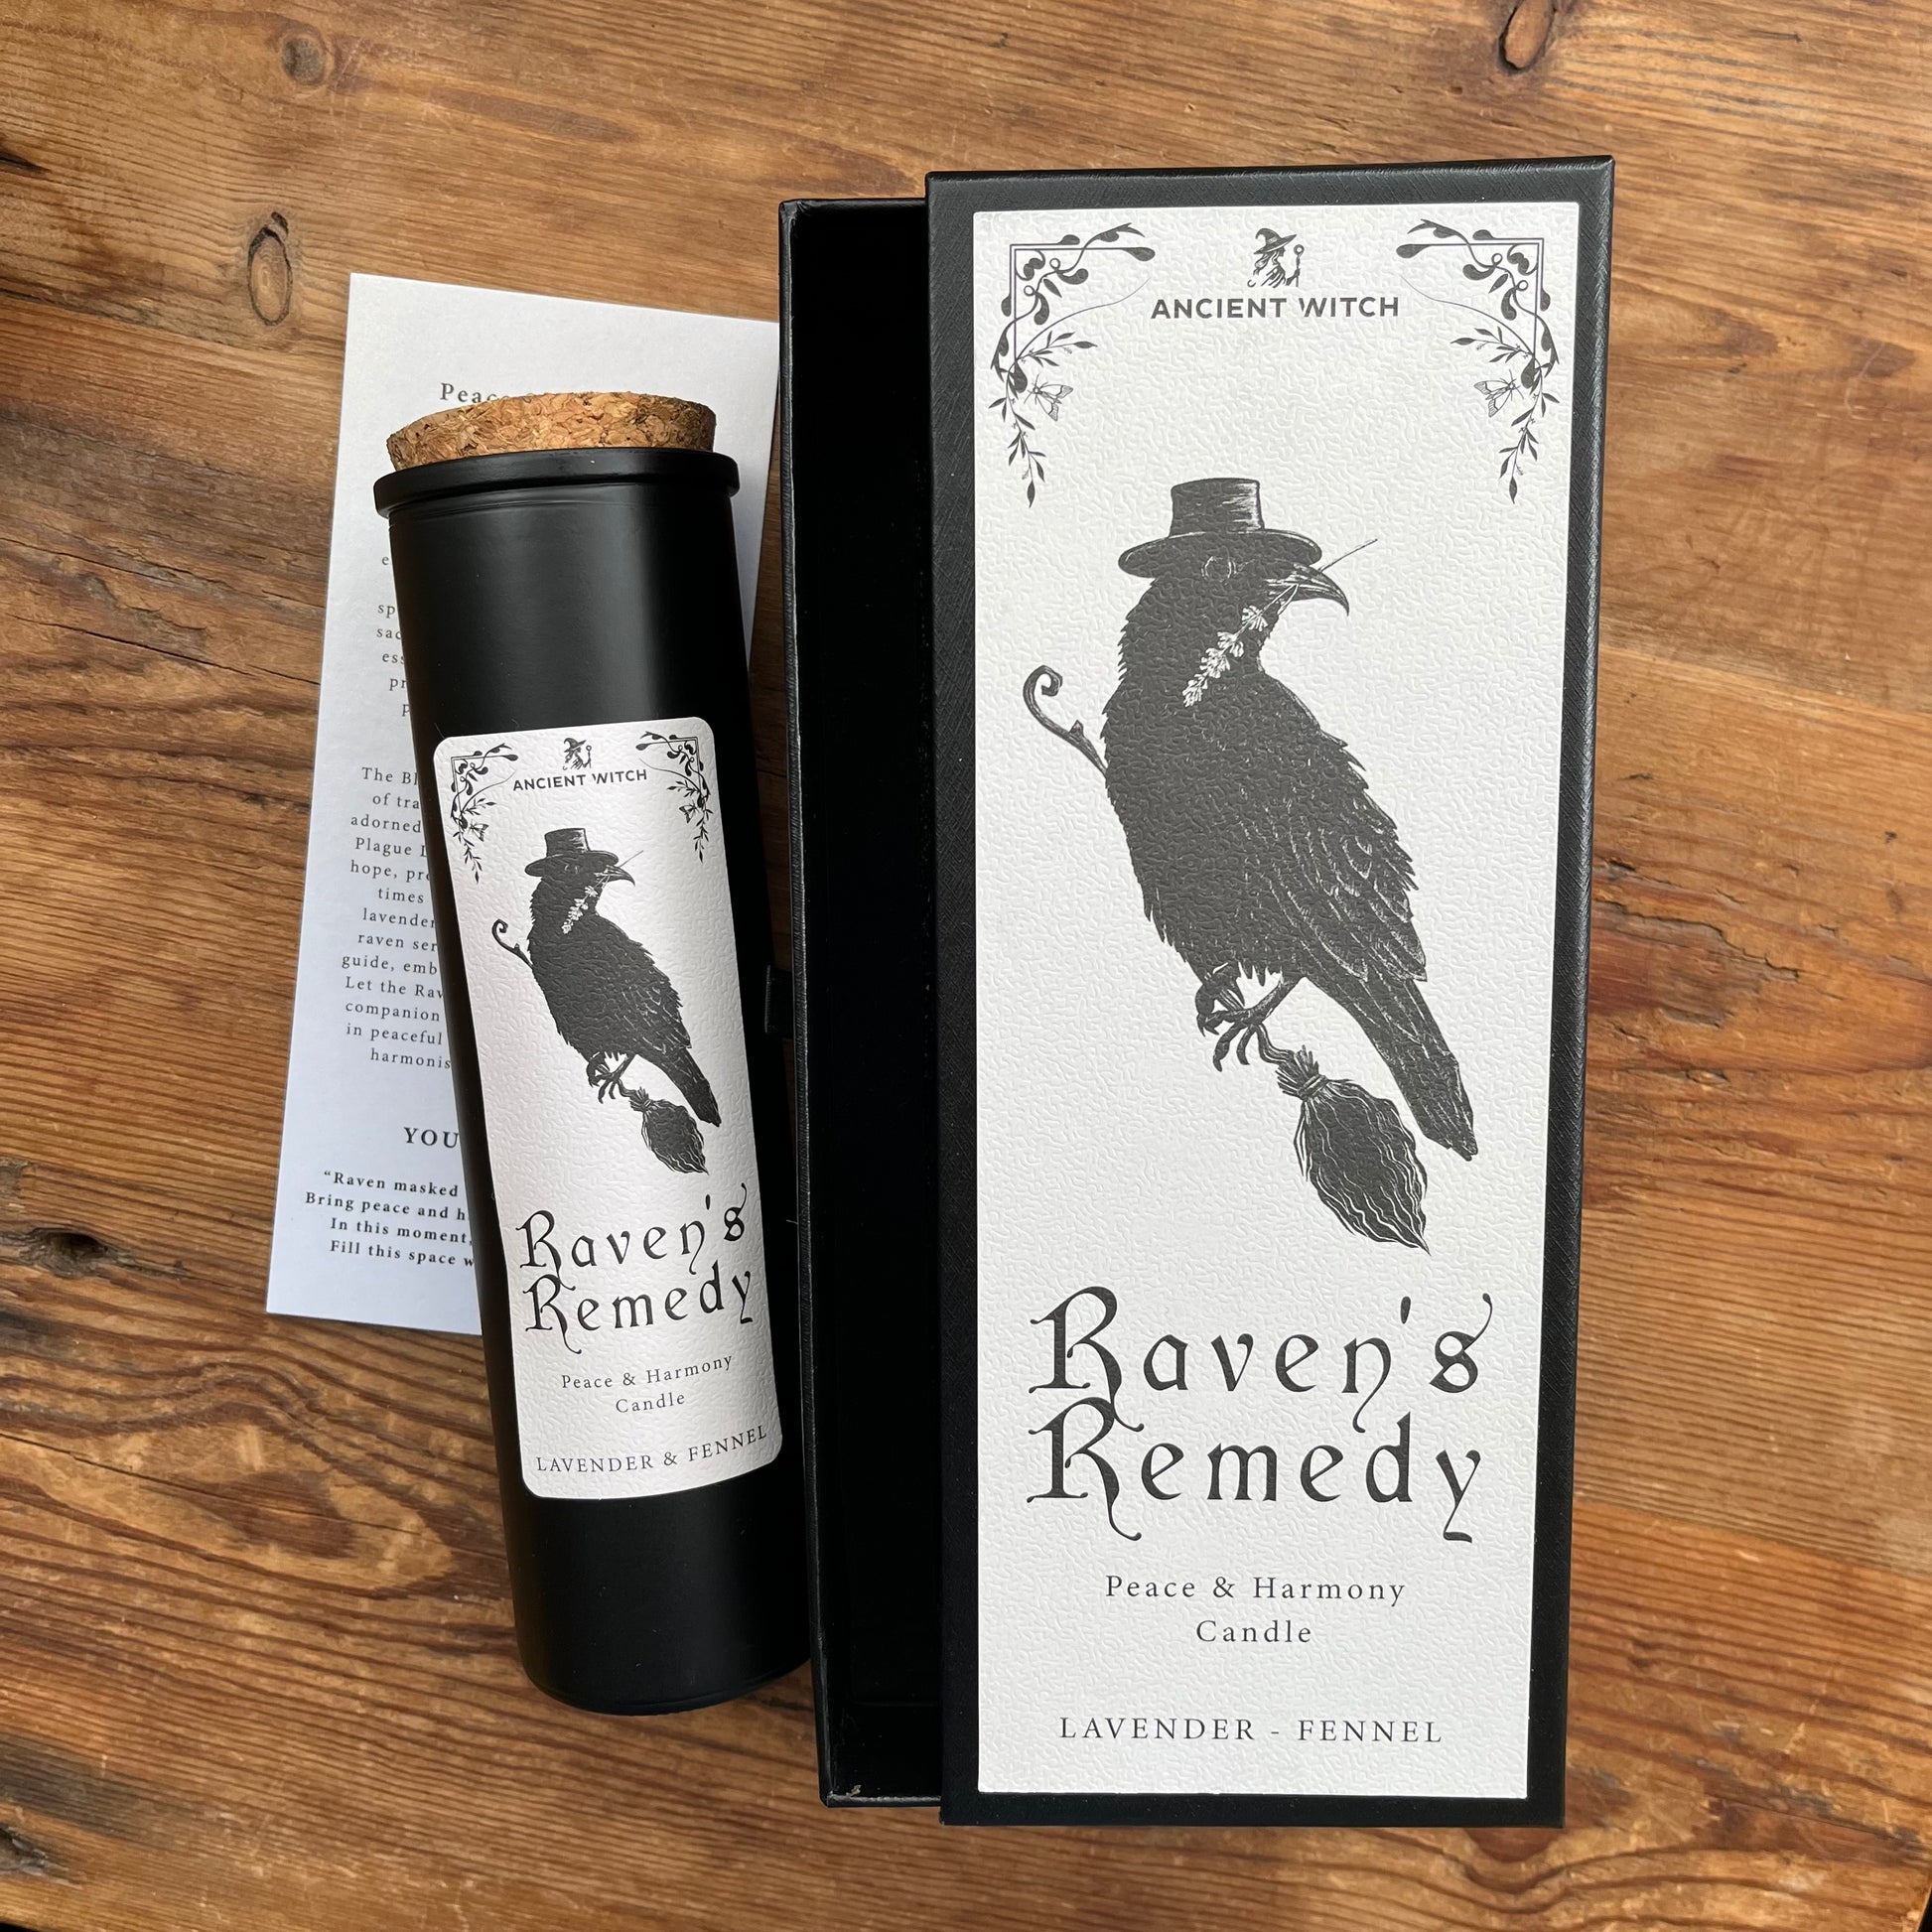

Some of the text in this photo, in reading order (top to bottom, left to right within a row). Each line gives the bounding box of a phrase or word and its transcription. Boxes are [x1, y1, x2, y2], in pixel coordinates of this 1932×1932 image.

[1151, 296, 1400, 320] ANCIENT WITCH
[361, 766, 393, 782] The
[513, 769, 648, 791] ANCIENT WITCH
[372, 792, 391, 806] of
[350, 814, 421, 833] adorned
[354, 837, 412, 857] Plague
[350, 859, 398, 880] hope,
[378, 888, 424, 903] times
[357, 933, 404, 948] raven
[342, 955, 395, 971] guide,
[345, 976, 372, 991] Let
[380, 980, 407, 995] the
[345, 1002, 440, 1022] companion
[346, 1023, 443, 1045] in peaceful
[394, 1181, 459, 1197] masked
[305, 1191, 354, 1211] Bring
[360, 1199, 410, 1214] peace
[417, 1206, 449, 1219] and
[330, 1217, 347, 1230] In
[356, 1220, 389, 1235] this
[515, 1182, 748, 1291] Raven's
[330, 1240, 360, 1255] Fill
[368, 1244, 401, 1259] this
[408, 1250, 457, 1265] space
[522, 1260, 753, 1354] Remedy
[1029, 1286, 1492, 1432] Raven's
[562, 1355, 732, 1389] Peace & Harmony
[616, 1392, 685, 1413] Candle
[536, 1425, 766, 1472] LAVENDER & FENNEL
[1027, 1396, 1481, 1543] Remedy
[1105, 1575, 1406, 1606] Peace & Harmony
[1196, 1618, 1312, 1643] Candle
[1059, 1717, 1255, 1741] LAVENDER
[1298, 1719, 1443, 1743] FENNEL
